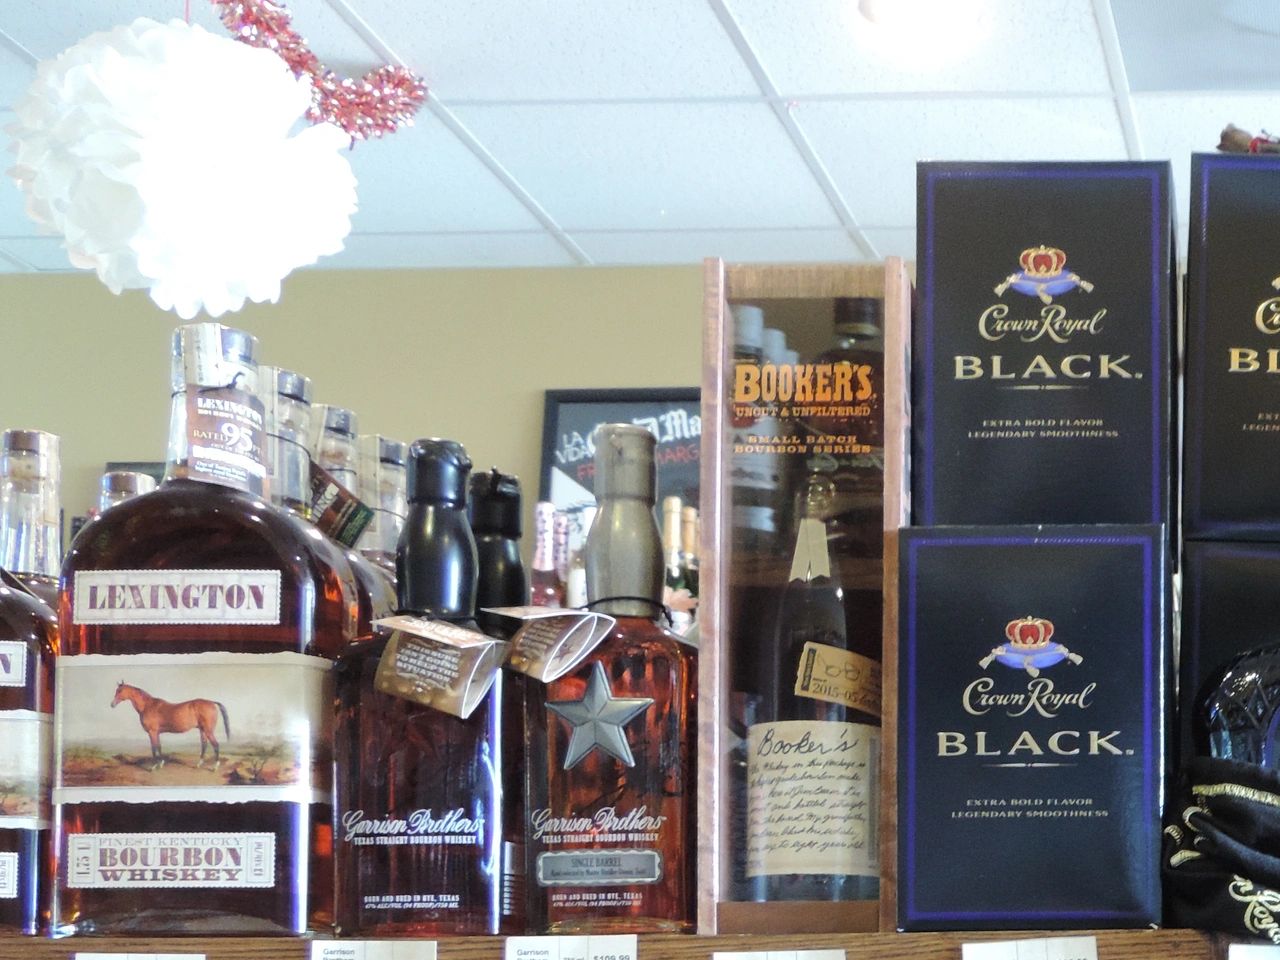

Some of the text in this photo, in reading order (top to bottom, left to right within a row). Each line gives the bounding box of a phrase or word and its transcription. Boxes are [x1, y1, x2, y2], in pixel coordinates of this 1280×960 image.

[978, 303, 1108, 344] Crown Royal
[734, 363, 873, 402] BOOKER'S
[736, 406, 778, 417] UNCUT
[792, 406, 871, 417] UNFILTERED
[982, 418, 1103, 427] EXTRA BOLD FLAVOR
[221, 422, 253, 452] 95
[748, 435, 858, 444] SMALL BATCH
[968, 430, 1118, 439] LEGENDARY SMOOTHNESS
[734, 445, 873, 454] BOURBON SERIES
[88, 584, 266, 611] LEXINGTON
[962, 677, 1097, 718] Crown Royal
[966, 798, 1093, 806] EXTRA BOLD FLAVOR
[951, 810, 1109, 819] LEGENDARY SMOOTHNESS
[342, 807, 485, 841] Garrison Brothers
[532, 805, 667, 840] Garrison Brothers
[99, 837, 242, 847] FINEST KENTUCKY
[354, 835, 477, 845] TEXAS STRAIGHT BOURBON WHISKEY
[99, 847, 242, 867] BOURBON
[97, 867, 243, 882] WHISKEY
[516, 948, 549, 956] Garrison
